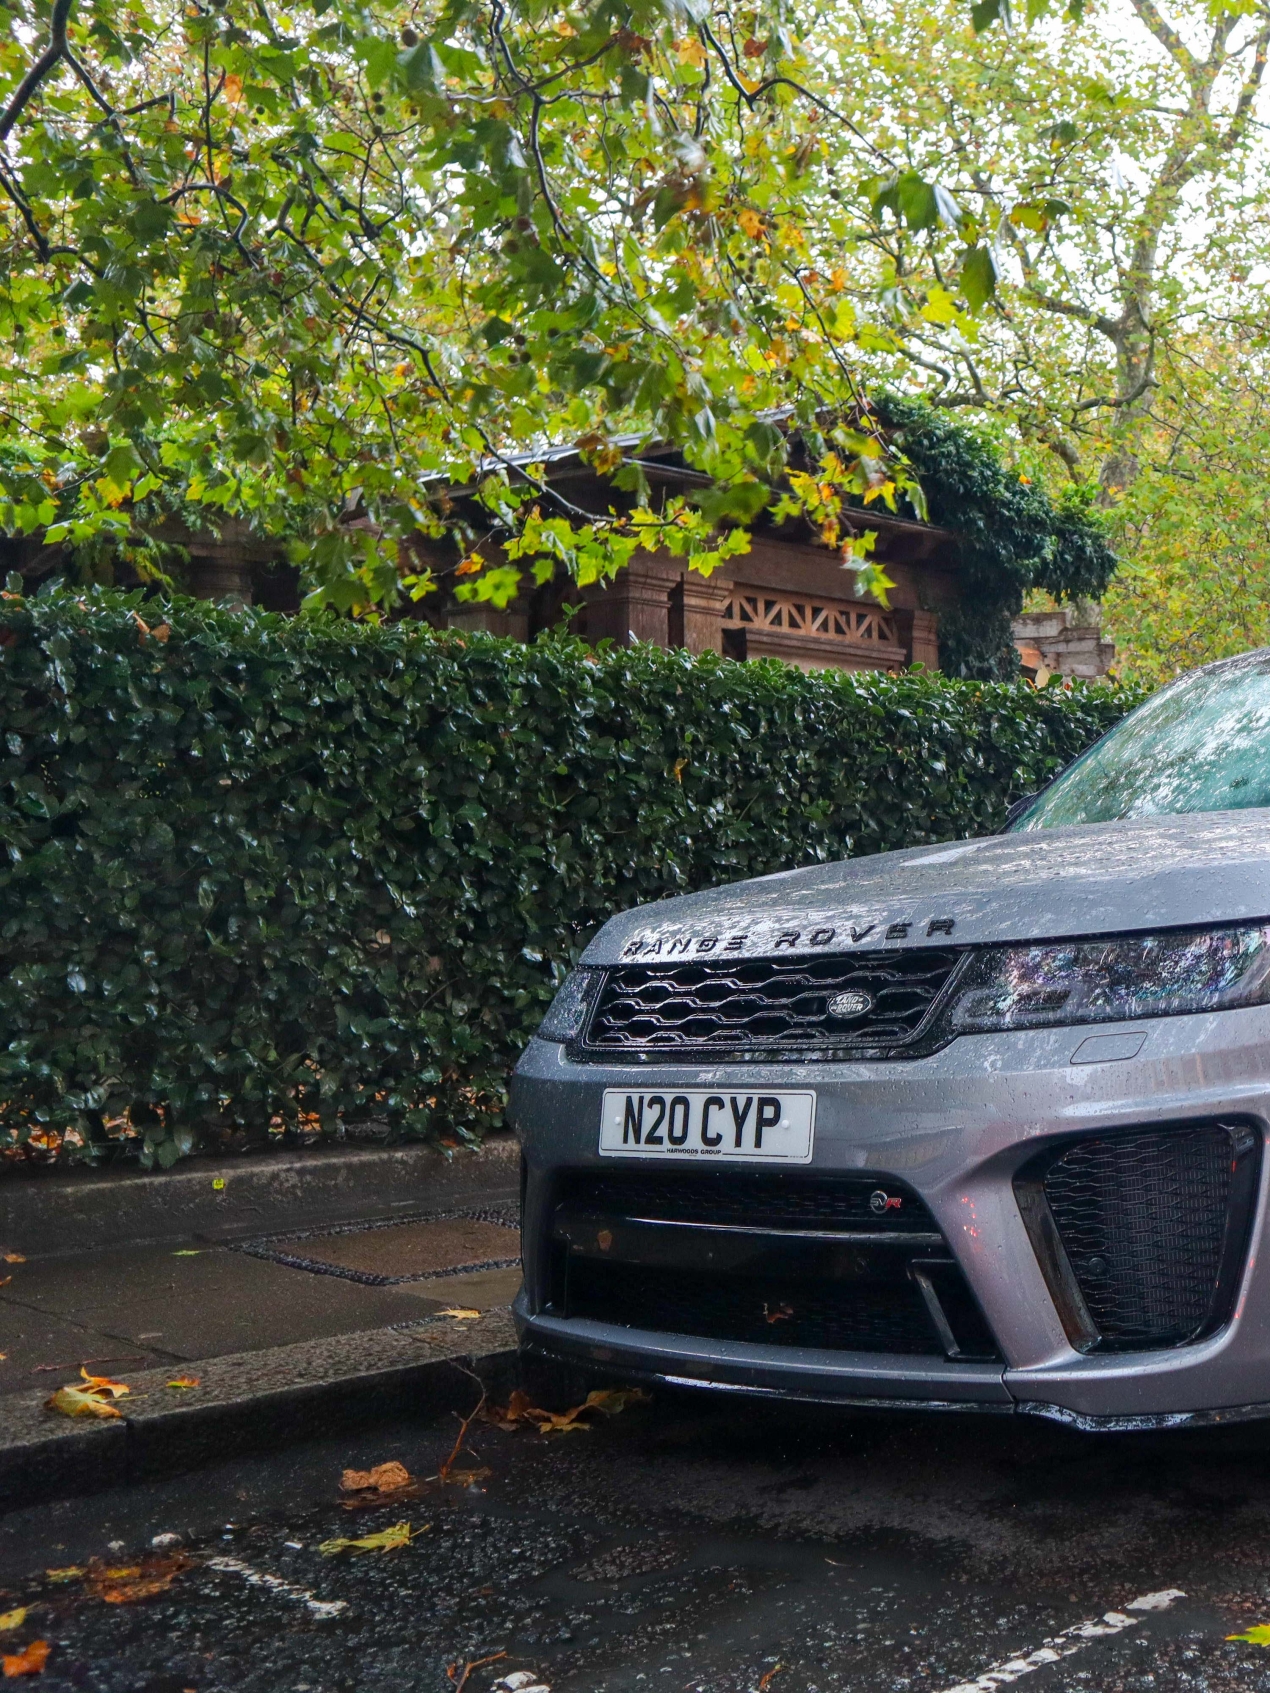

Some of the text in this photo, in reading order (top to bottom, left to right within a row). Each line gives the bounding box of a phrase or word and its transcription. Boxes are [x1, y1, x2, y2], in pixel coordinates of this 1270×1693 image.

[623, 918, 956, 956] RANGE ROVER
[835, 994, 860, 1004] LAND
[836, 1003, 863, 1013] ROVER
[623, 1095, 782, 1149] N20 CYP
